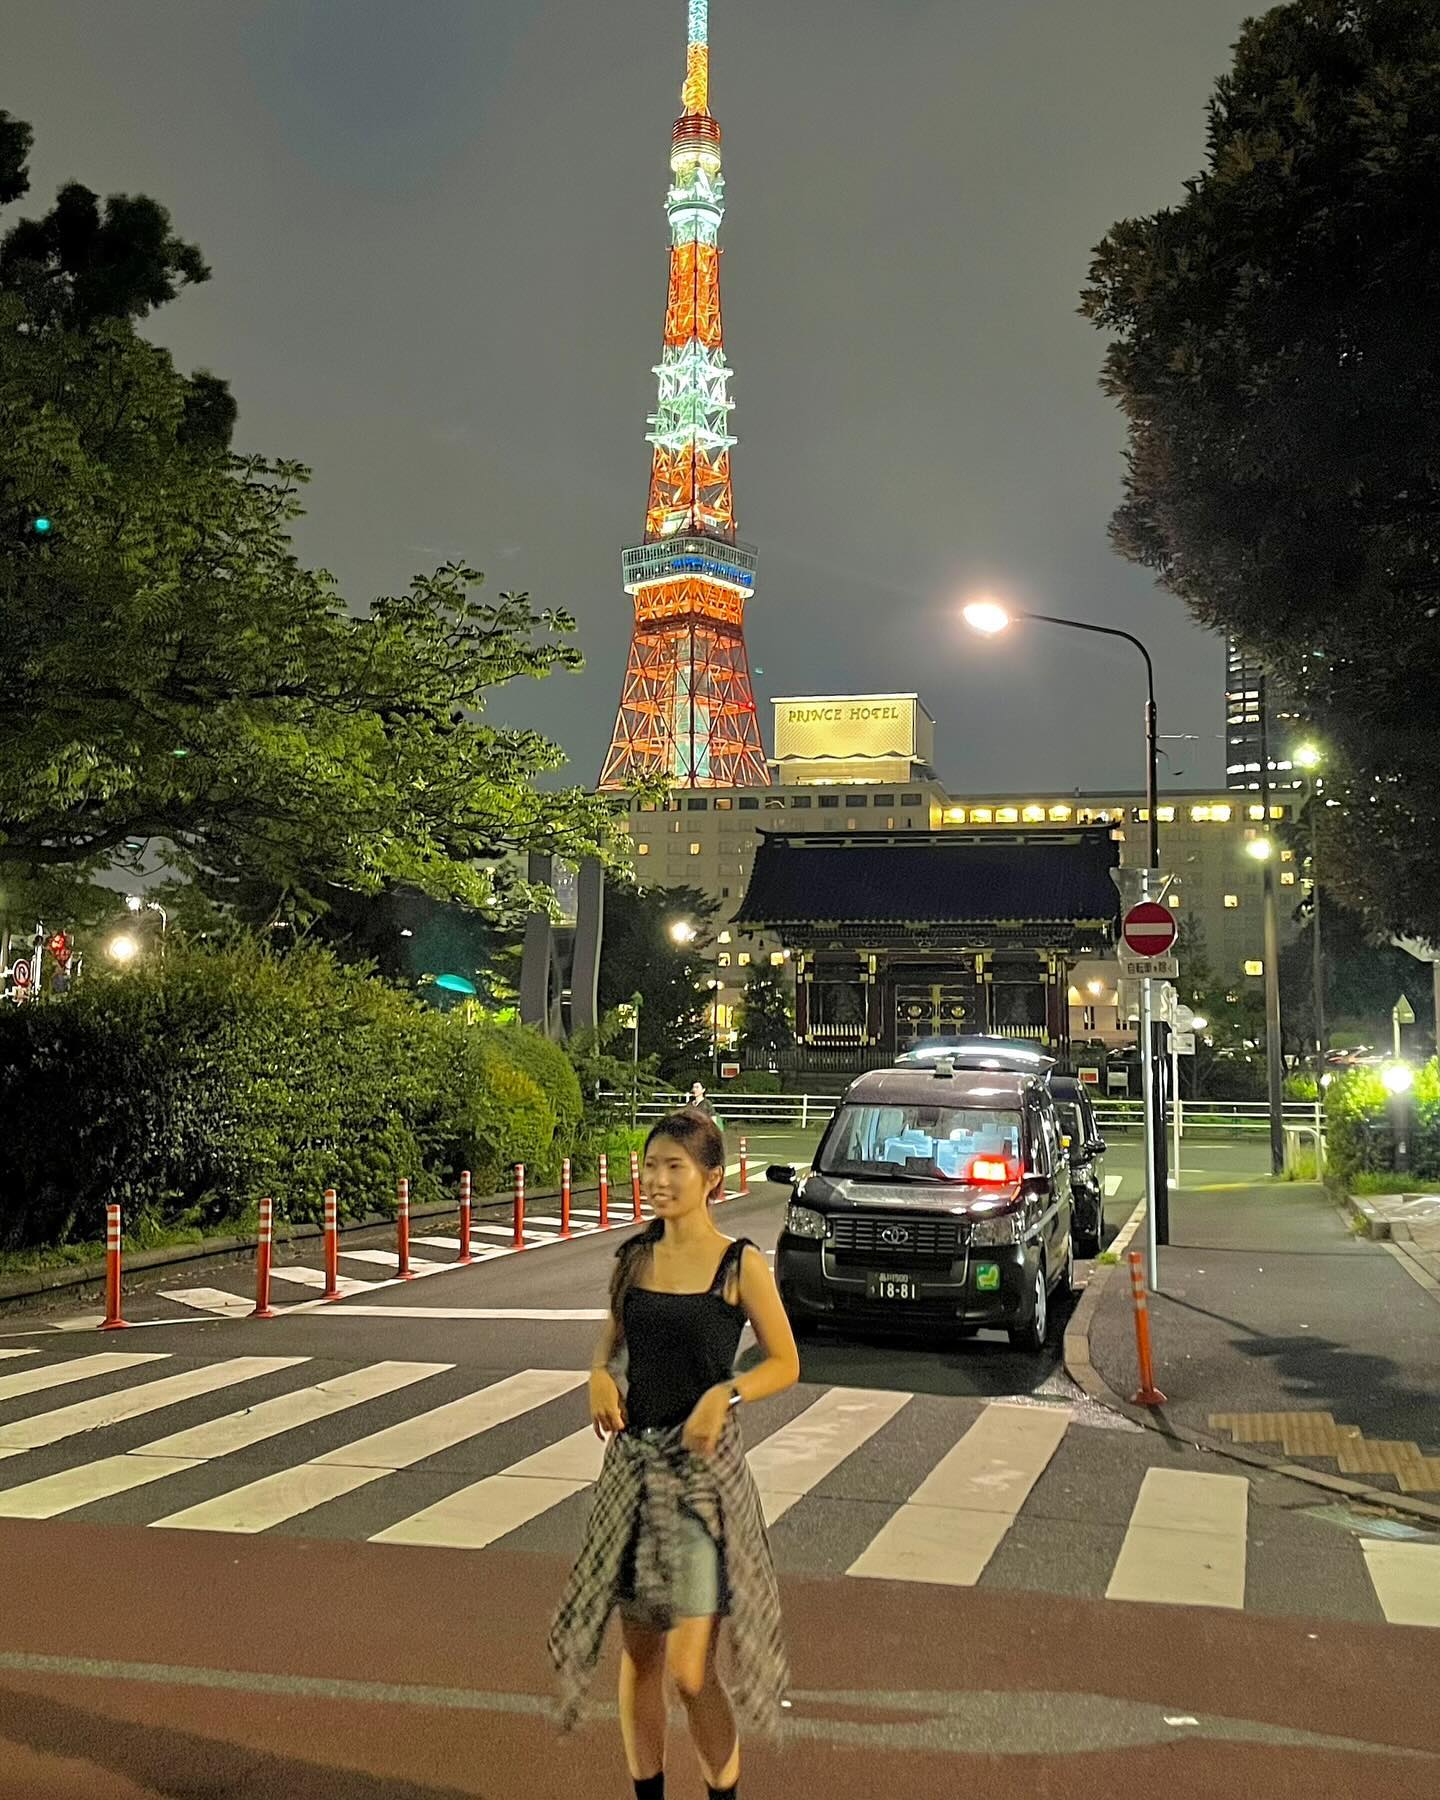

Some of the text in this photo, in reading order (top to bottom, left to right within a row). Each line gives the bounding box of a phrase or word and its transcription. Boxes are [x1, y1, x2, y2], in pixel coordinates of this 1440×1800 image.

[788, 707, 899, 722] PRINCE HOTEL
[880, 1282, 915, 1299] 18-81
